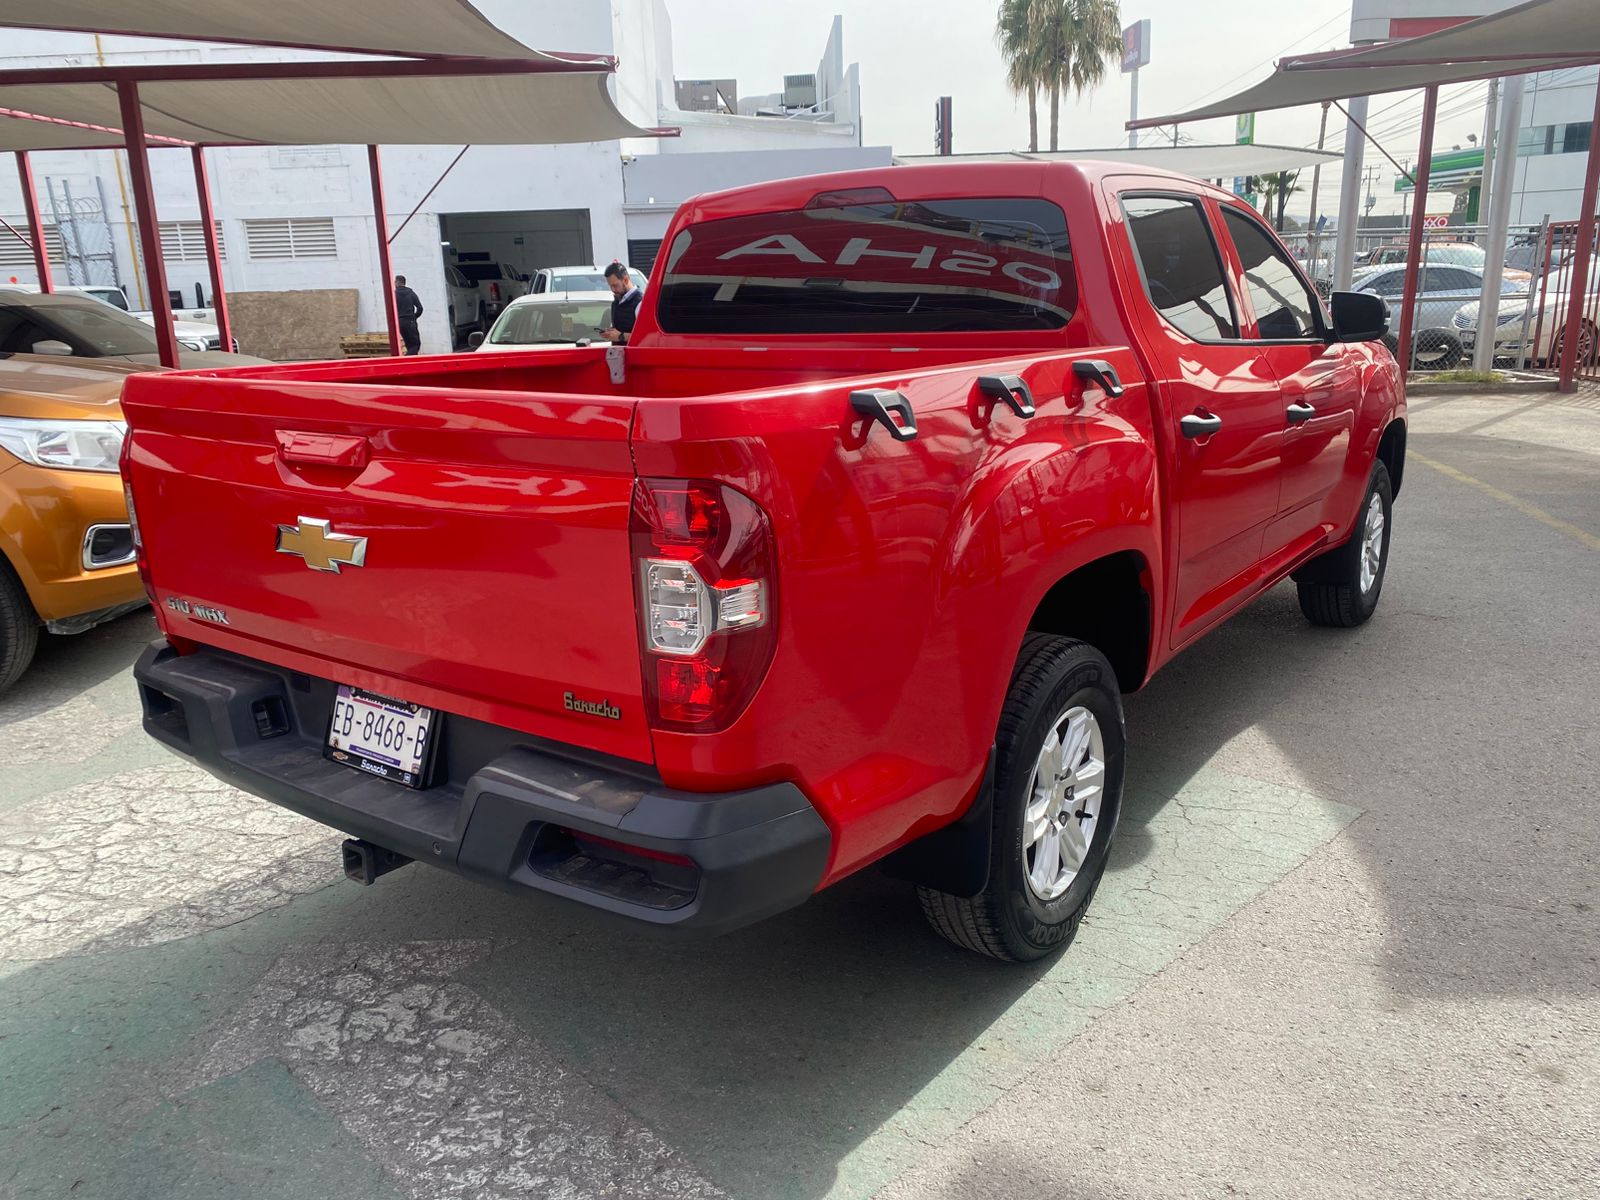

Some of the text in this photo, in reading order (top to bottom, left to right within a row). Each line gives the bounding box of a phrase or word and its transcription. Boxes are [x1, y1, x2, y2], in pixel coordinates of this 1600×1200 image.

[1424, 215, 1448, 228] XXO
[194, 603, 231, 625] MAX
[332, 700, 427, 761] EB-8468-B
